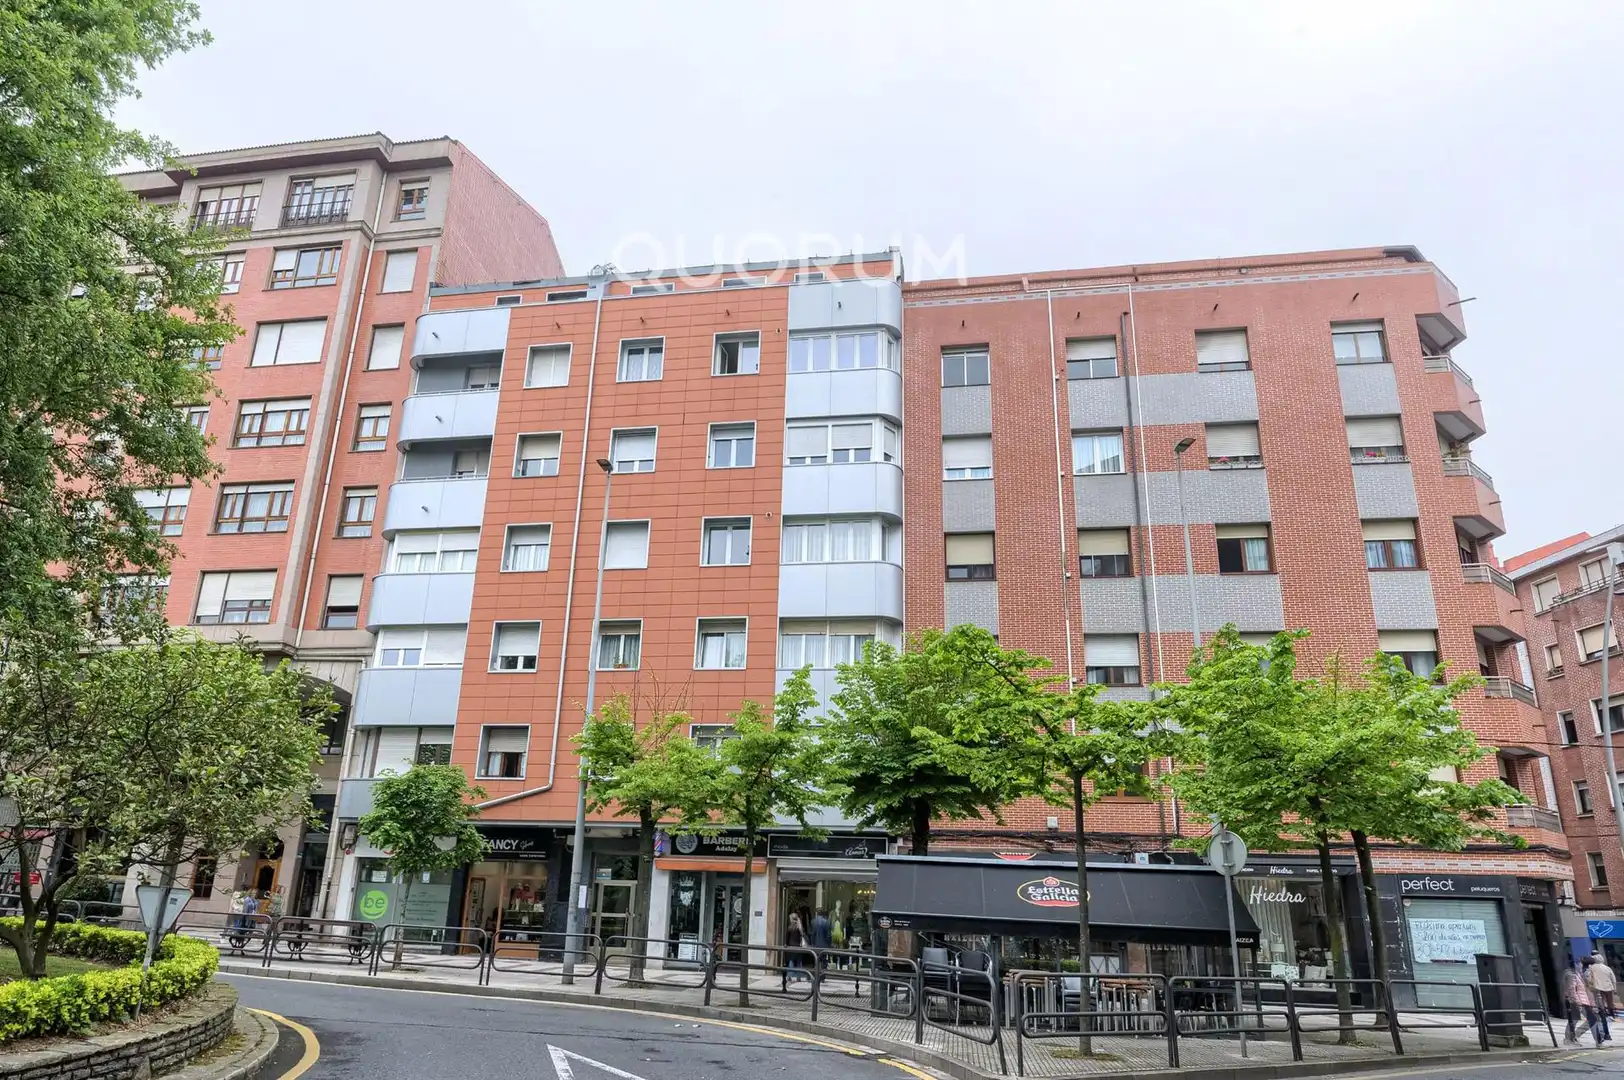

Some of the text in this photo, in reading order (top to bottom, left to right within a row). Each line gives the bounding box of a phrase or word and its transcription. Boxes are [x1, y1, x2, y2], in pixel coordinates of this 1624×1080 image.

[481, 839, 519, 850] FANCY
[1269, 866, 1294, 875] Hiedra
[1401, 876, 1455, 893] perfect
[1027, 886, 1080, 896] Estrella
[1249, 885, 1307, 905] Hiedra
[363, 891, 385, 909] be
[1030, 893, 1079, 902] Galicia
